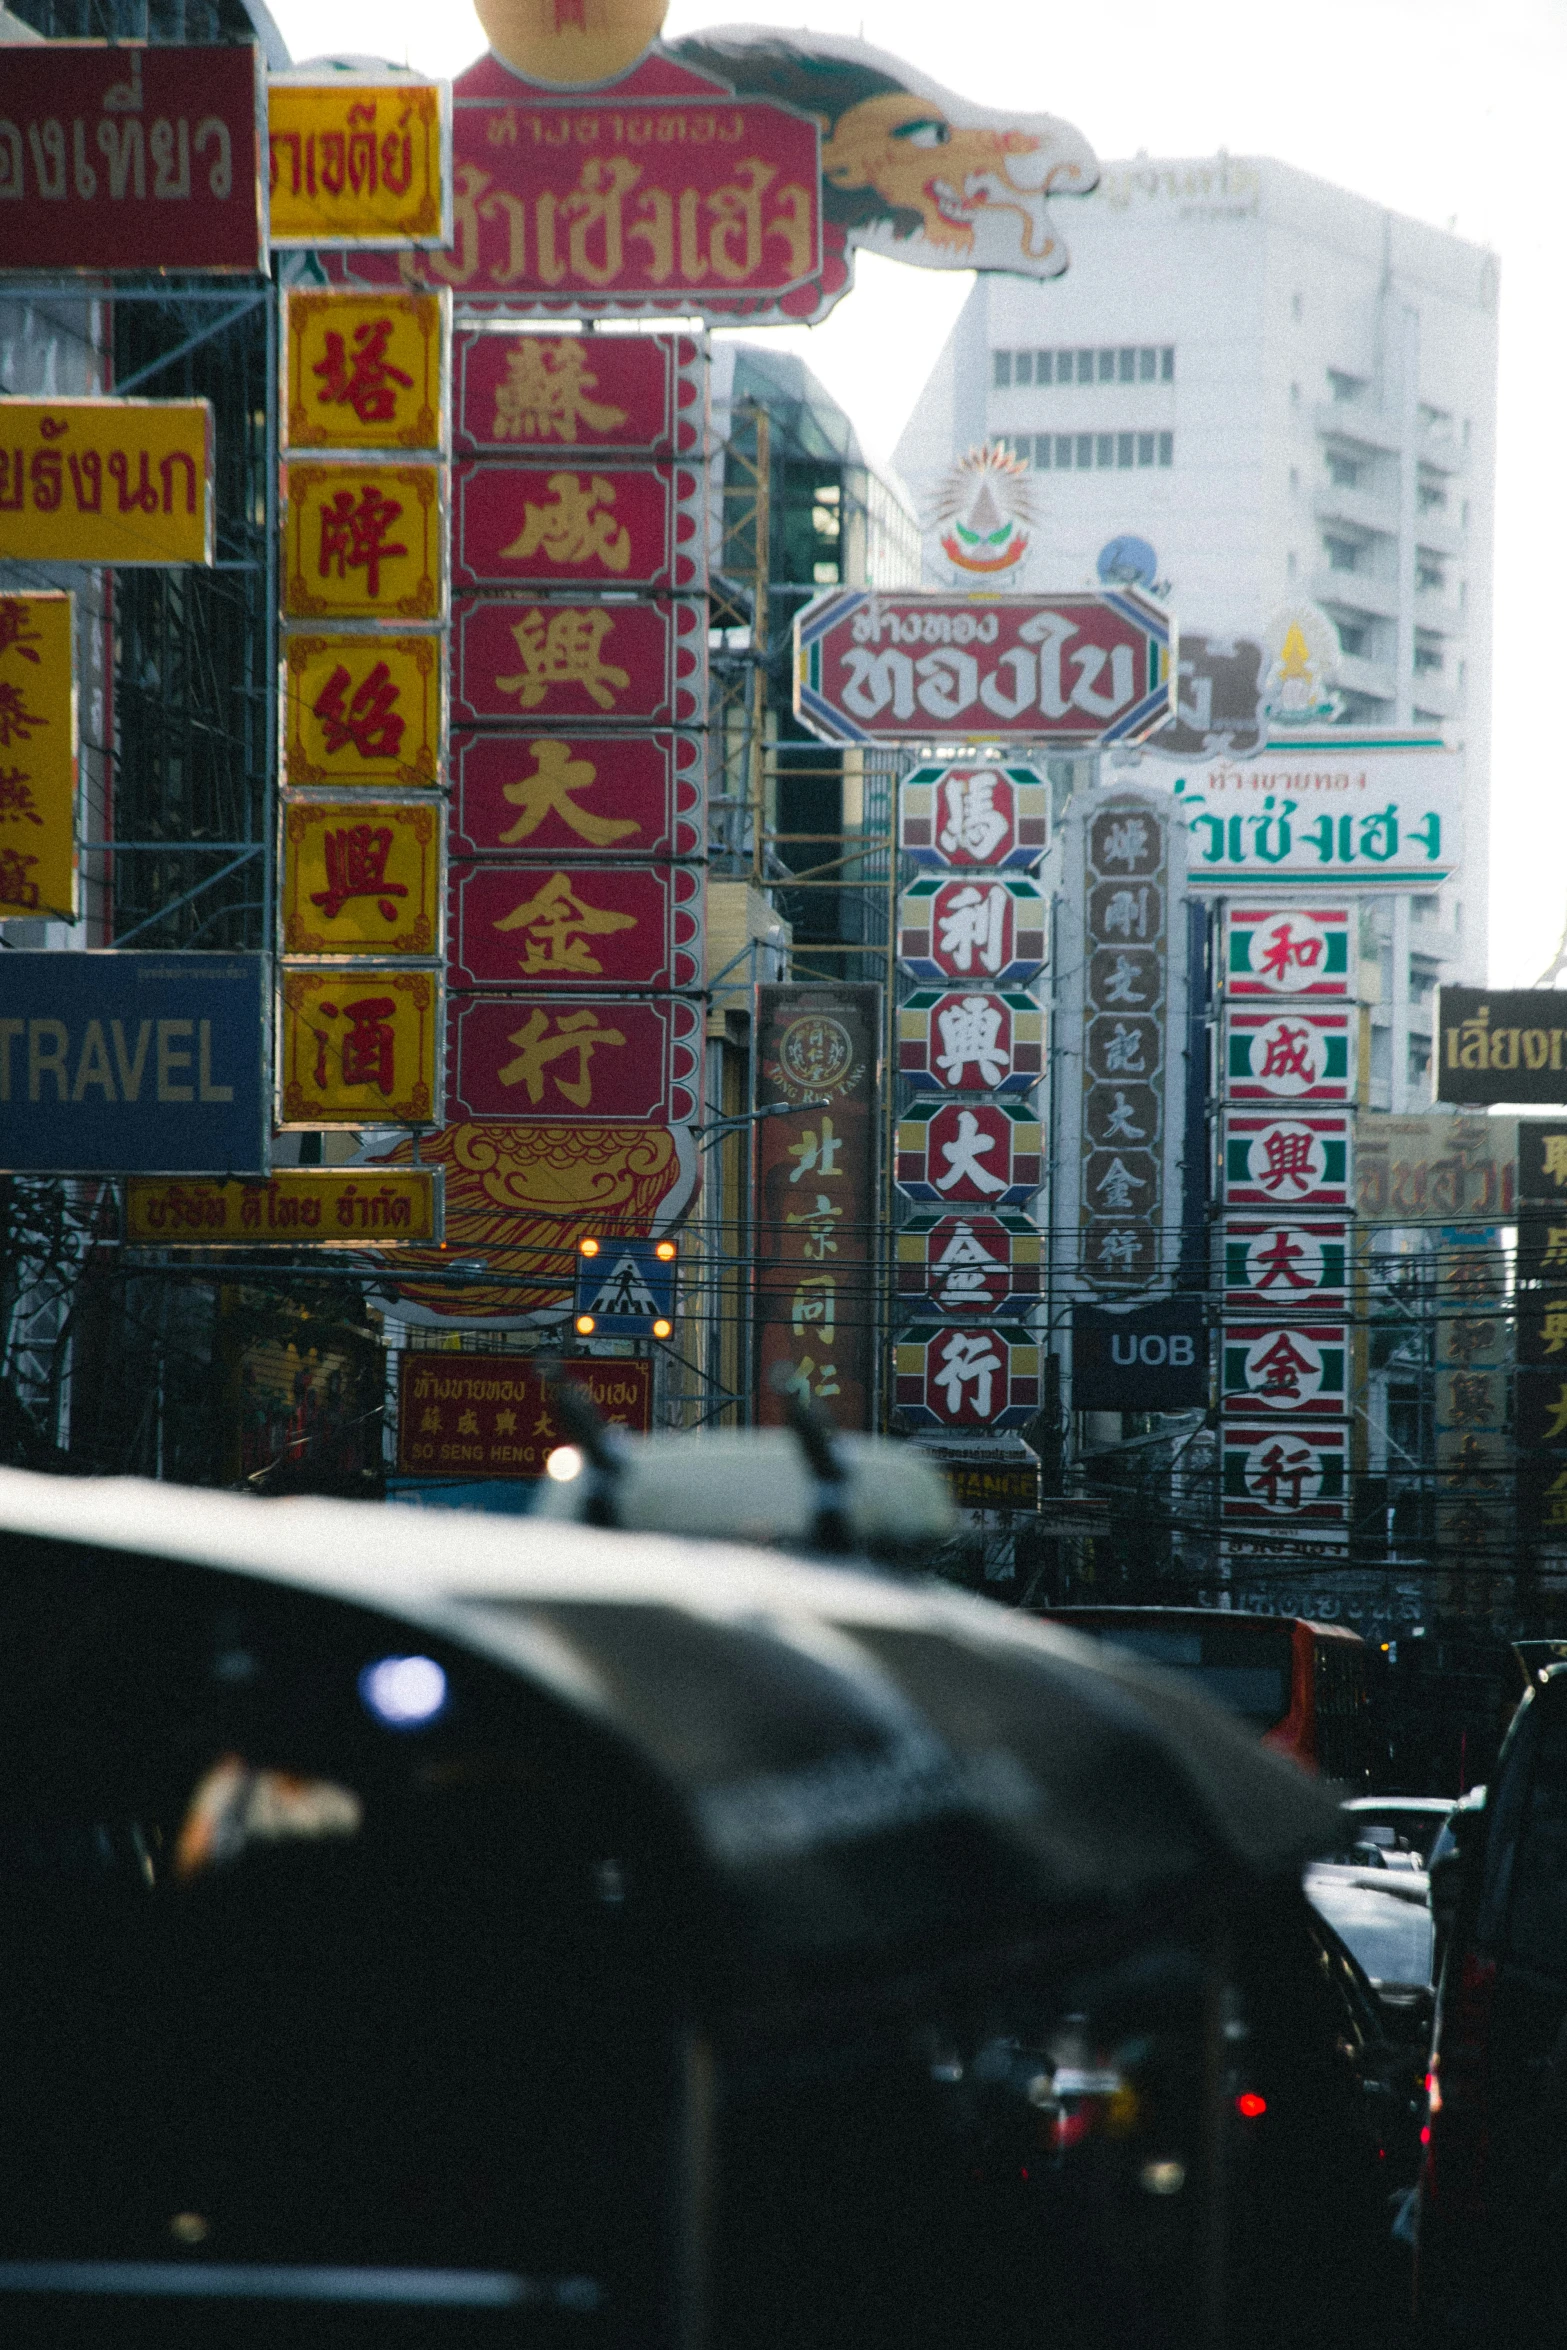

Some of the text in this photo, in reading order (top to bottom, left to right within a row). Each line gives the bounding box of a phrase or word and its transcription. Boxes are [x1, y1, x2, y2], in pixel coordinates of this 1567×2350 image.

[1255, 922, 1332, 1507] 和成興大金行
[1111, 1334, 1195, 1366] UOB
[412, 1443, 434, 1460] SO
[440, 1444, 484, 1461] SENG
[490, 1445, 536, 1463] HENG
